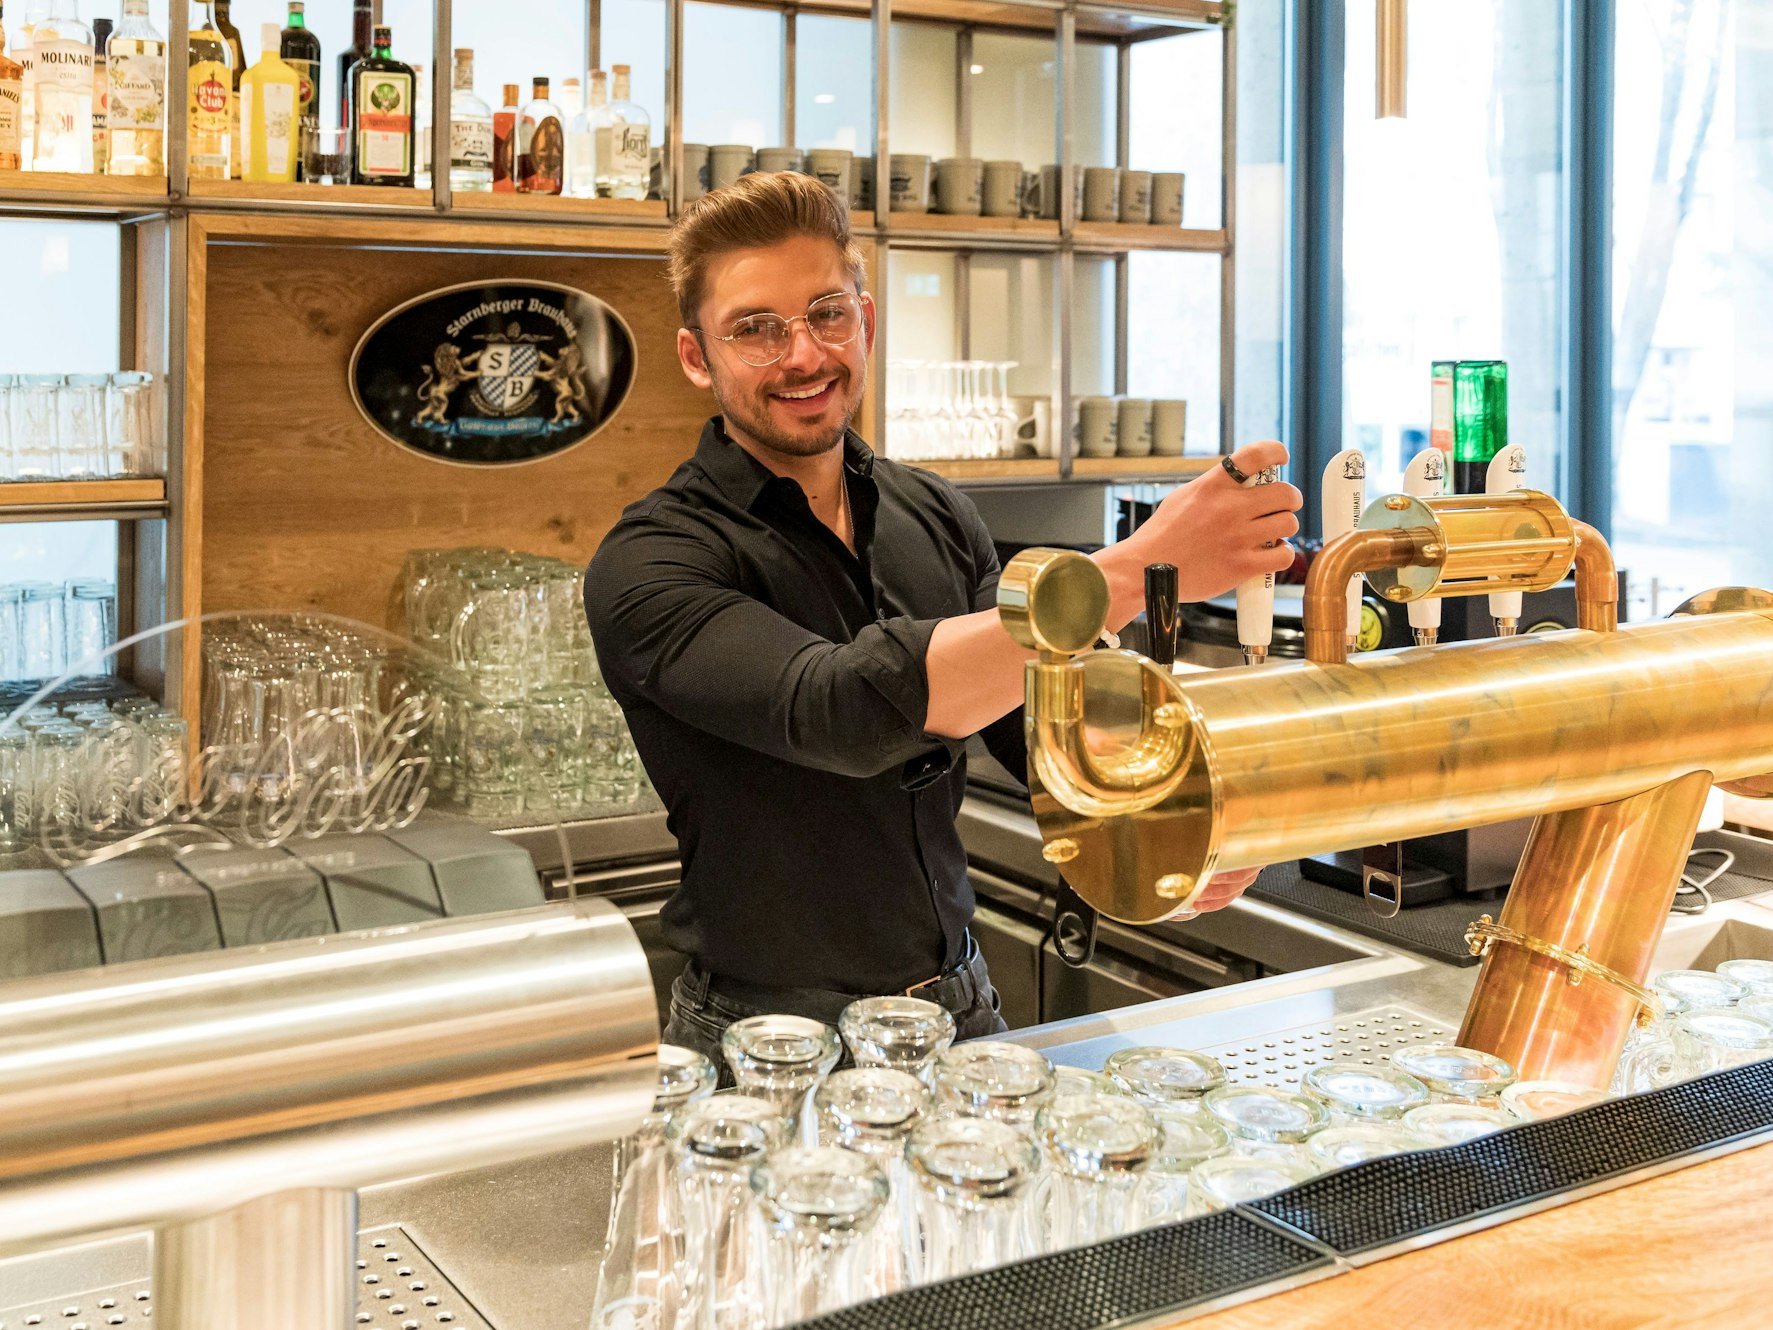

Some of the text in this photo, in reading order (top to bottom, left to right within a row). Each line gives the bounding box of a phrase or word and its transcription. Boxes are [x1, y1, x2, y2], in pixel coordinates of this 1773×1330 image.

[41, 52, 92, 66] MOLINARI
[200, 95, 224, 109] Club
[446, 298, 577, 340] Starnberger Brauhaus
[489, 352, 503, 370] S
[510, 381, 523, 397] B
